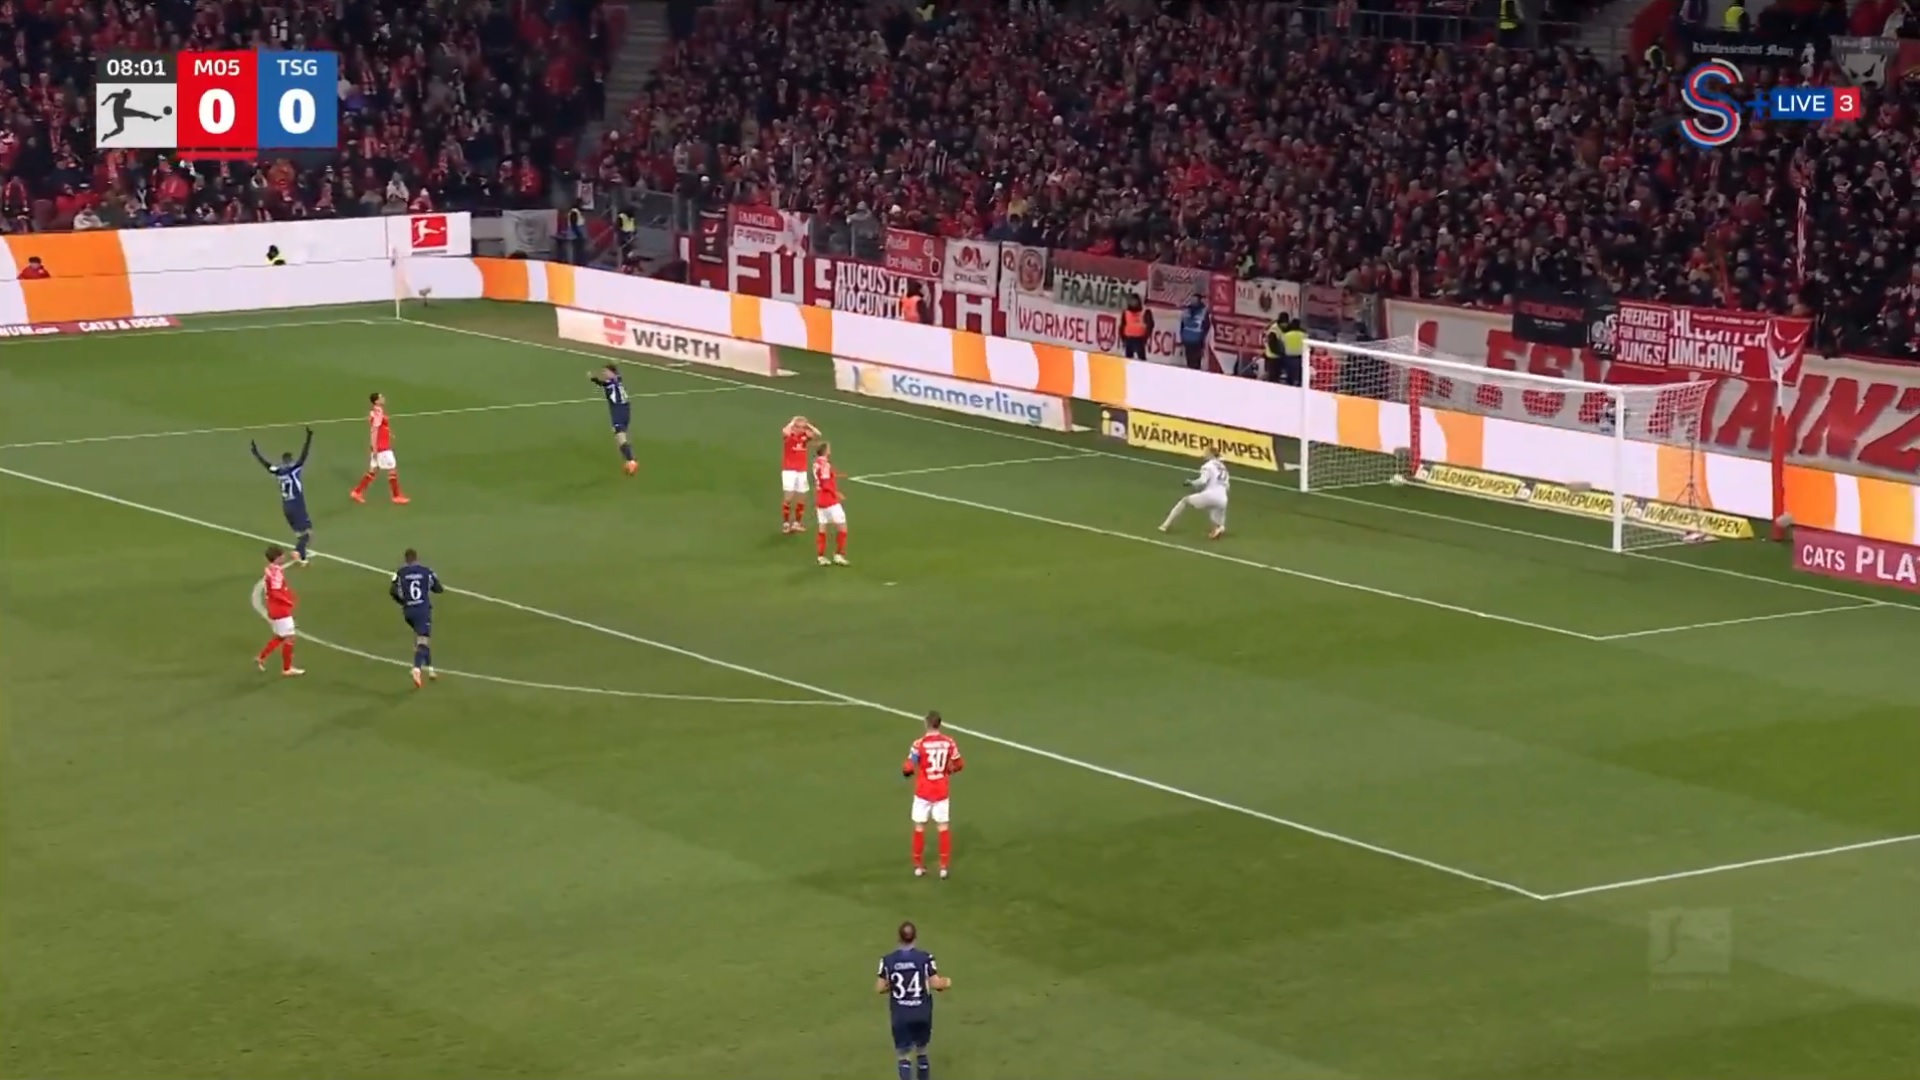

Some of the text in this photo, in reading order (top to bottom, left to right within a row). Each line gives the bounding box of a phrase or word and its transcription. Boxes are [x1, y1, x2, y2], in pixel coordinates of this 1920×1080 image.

[835, 261, 908, 296] AUGUSTA
[1060, 277, 1132, 309] FRAUEN
[834, 286, 905, 320] MOCUNTI
[1619, 307, 1669, 330] FREIHEIT
[78, 320, 117, 332] CATS
[130, 317, 170, 329] DOGS
[1018, 305, 1093, 345] WORMSEL
[632, 328, 720, 360] WÜRTH
[1616, 340, 1667, 366] JUNGS!
[1667, 338, 1745, 374] UMGANG
[892, 374, 1043, 424] Kömmerling
[1132, 422, 1272, 463] WÄRMEPUMPEN
[1533, 485, 1632, 514] WÄRMEPUMPN
[1802, 544, 1920, 584] CATS PLA
[410, 580, 422, 600] 6
[925, 748, 949, 773] 30
[891, 971, 922, 999] 34
